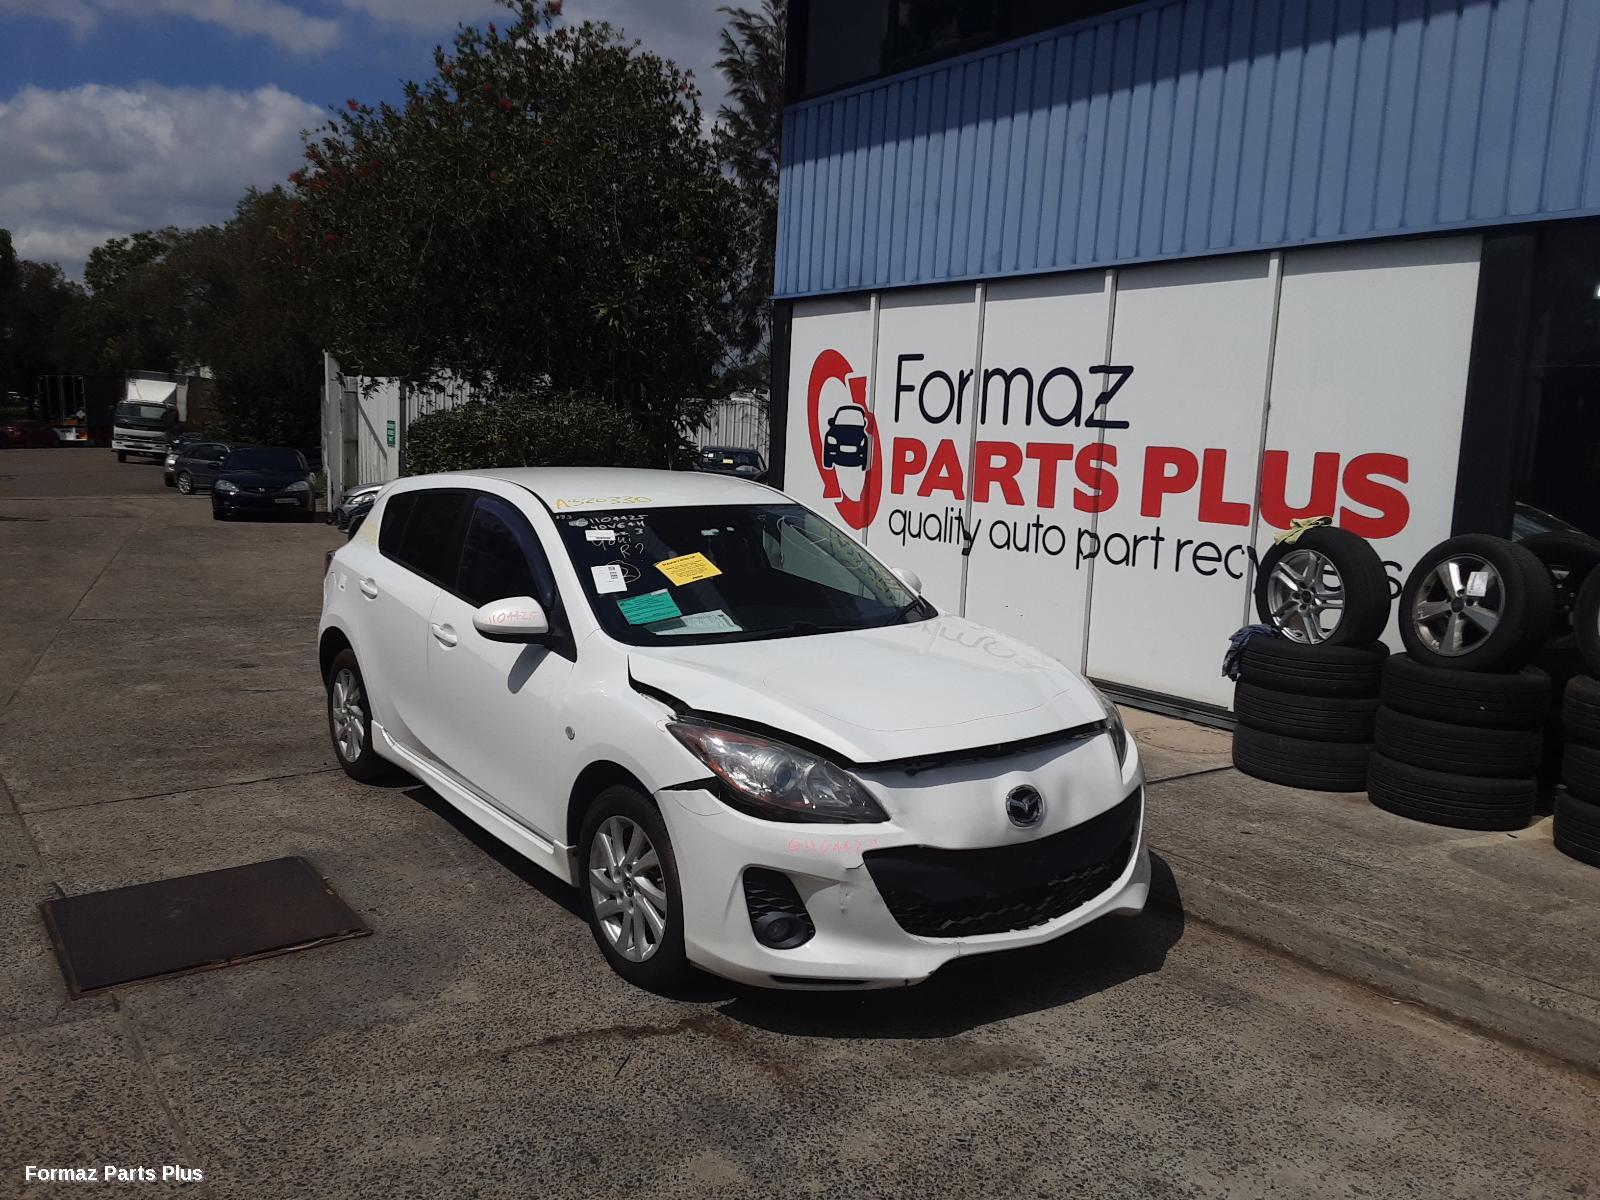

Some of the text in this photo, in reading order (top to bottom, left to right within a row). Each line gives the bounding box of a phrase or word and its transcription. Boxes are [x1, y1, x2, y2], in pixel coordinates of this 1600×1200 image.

[894, 353, 1134, 429] Formaz
[890, 436, 1411, 539] PARTS PLUS
[888, 506, 982, 556] quality
[989, 514, 1066, 556] auto
[1075, 525, 1166, 570] part
